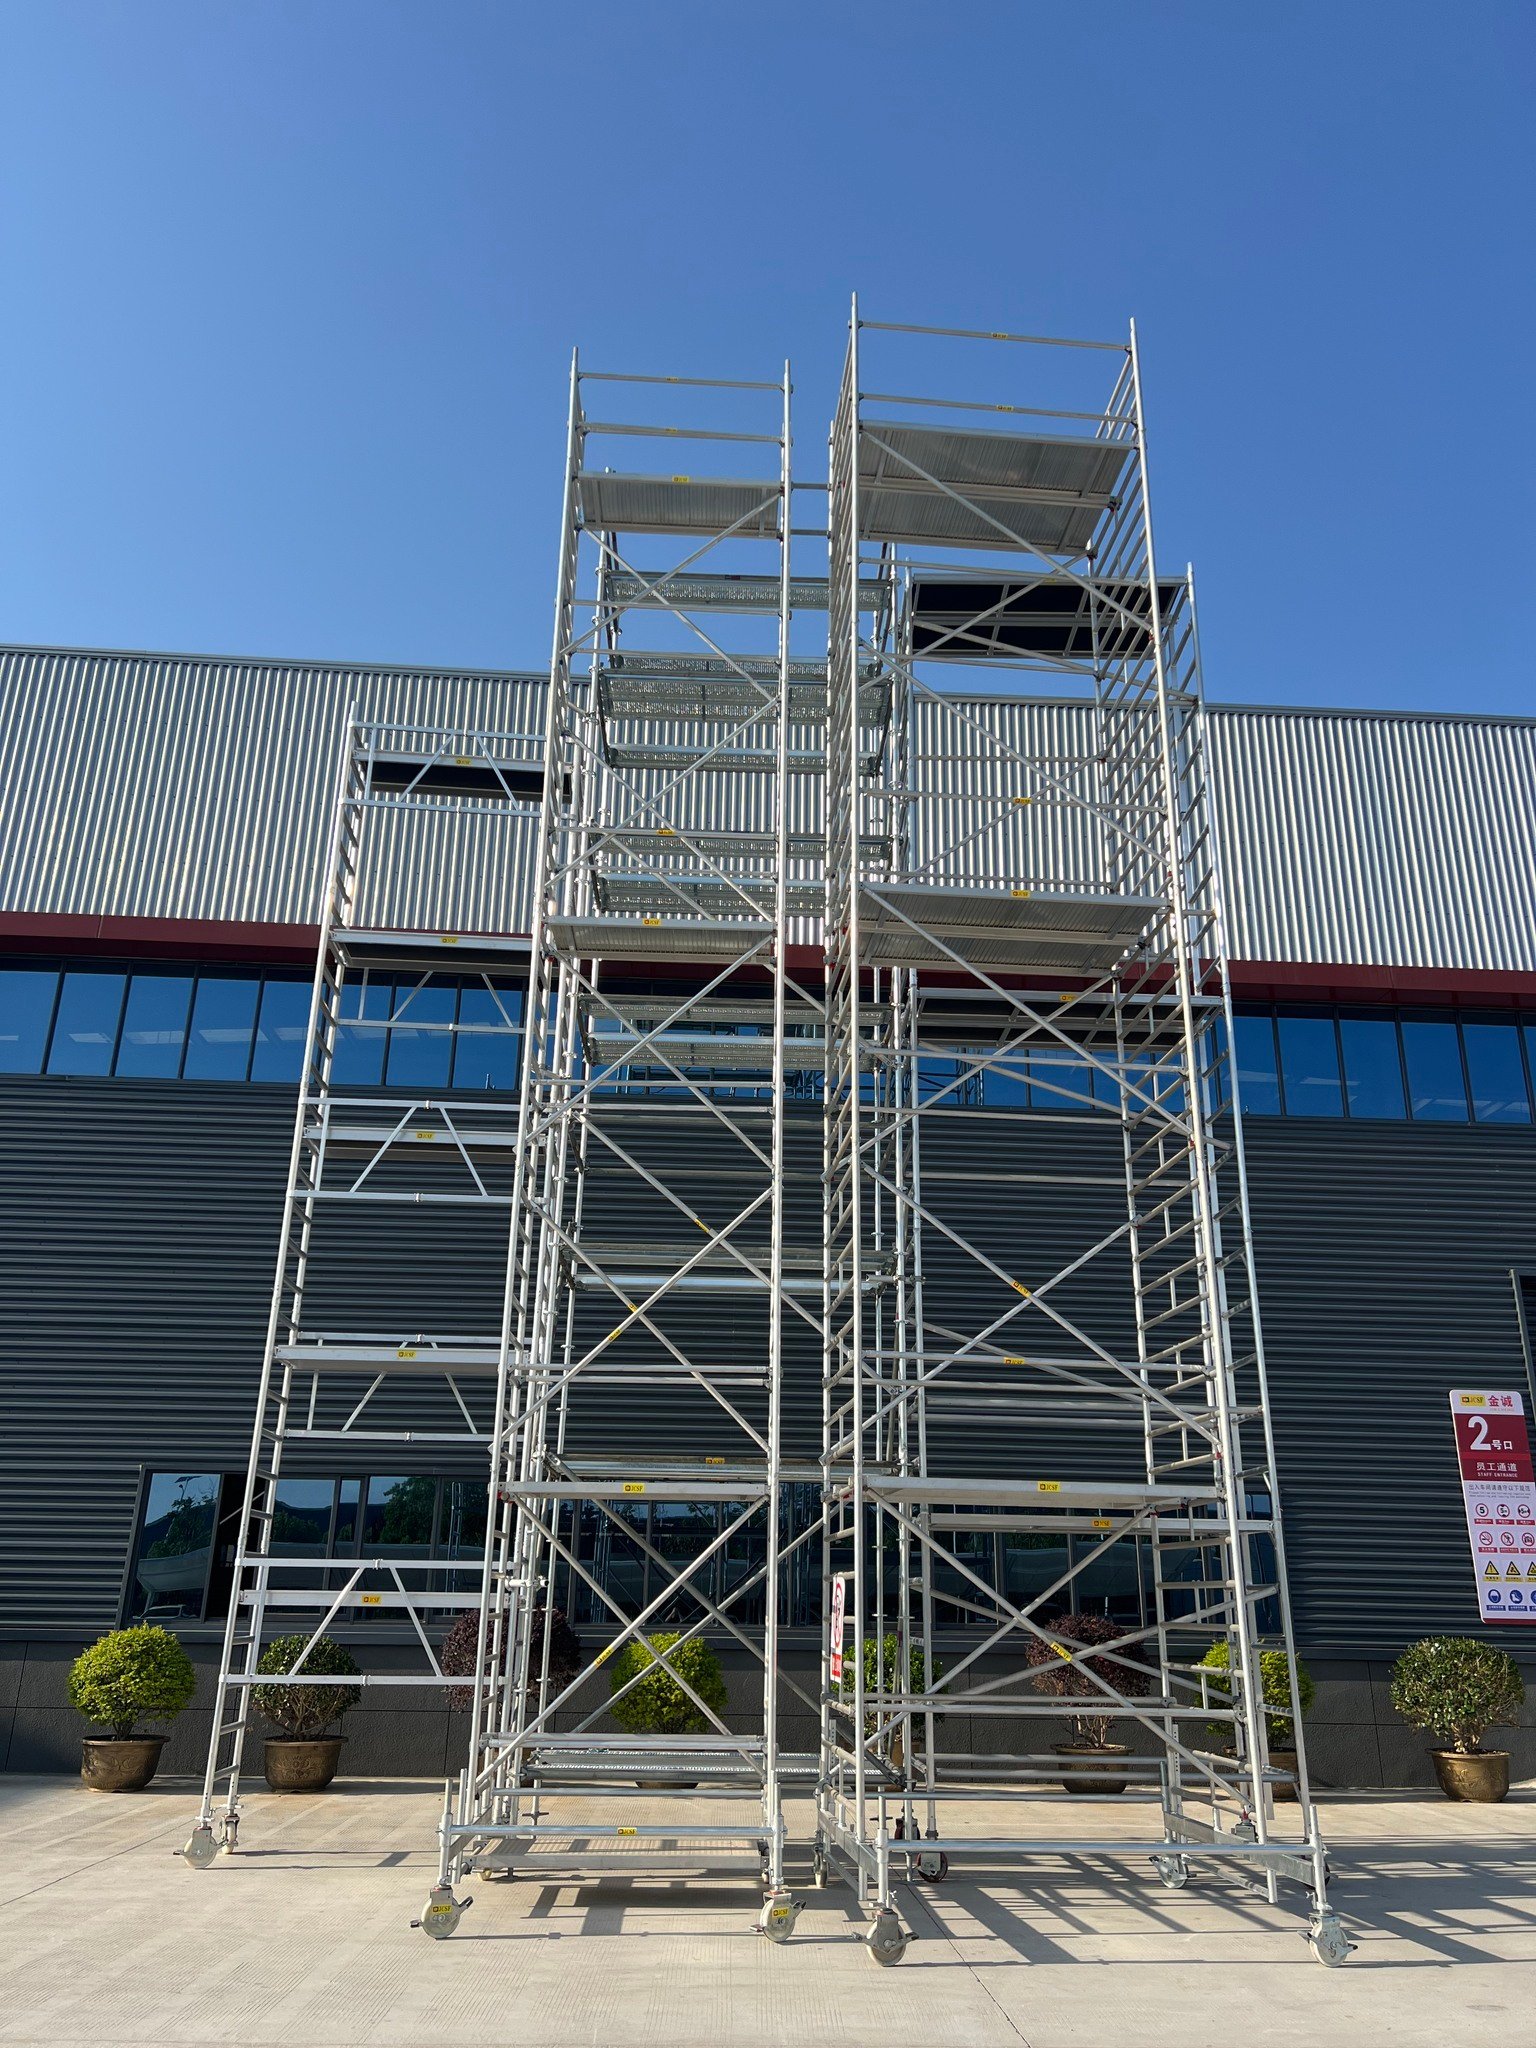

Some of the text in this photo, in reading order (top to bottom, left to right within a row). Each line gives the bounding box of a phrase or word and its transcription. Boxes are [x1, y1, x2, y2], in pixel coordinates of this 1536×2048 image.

[1487, 1395, 1513, 1407] 金诚
[1476, 1462, 1517, 1472] 员工通道
[1479, 1506, 1485, 1514] 5
